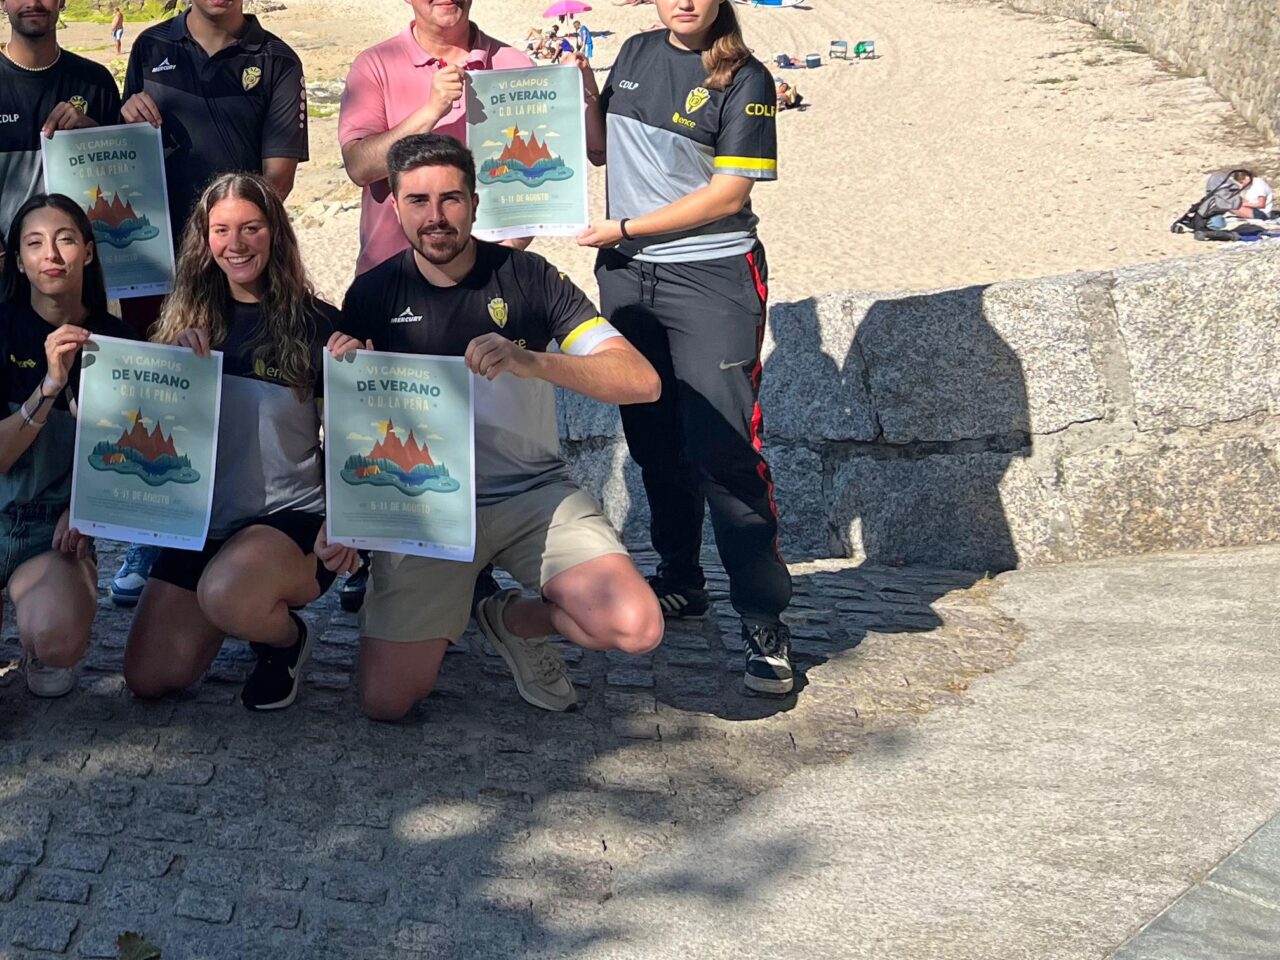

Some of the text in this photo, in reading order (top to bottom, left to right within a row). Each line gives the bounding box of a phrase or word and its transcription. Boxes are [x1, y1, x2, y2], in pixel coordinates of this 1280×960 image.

[498, 78, 549, 90] VI CAMPUS
[490, 90, 557, 106] DE VERANO
[515, 104, 525, 116] LA
[87, 138, 128, 150] CAMPUS
[69, 150, 137, 167] DE VERANO
[122, 355, 182, 372] VI CAMPUS
[112, 369, 190, 390] DE VERANO
[367, 365, 431, 380] VI CAMPUS
[357, 379, 441, 397] DE VERANO
[389, 395, 400, 409] LA
